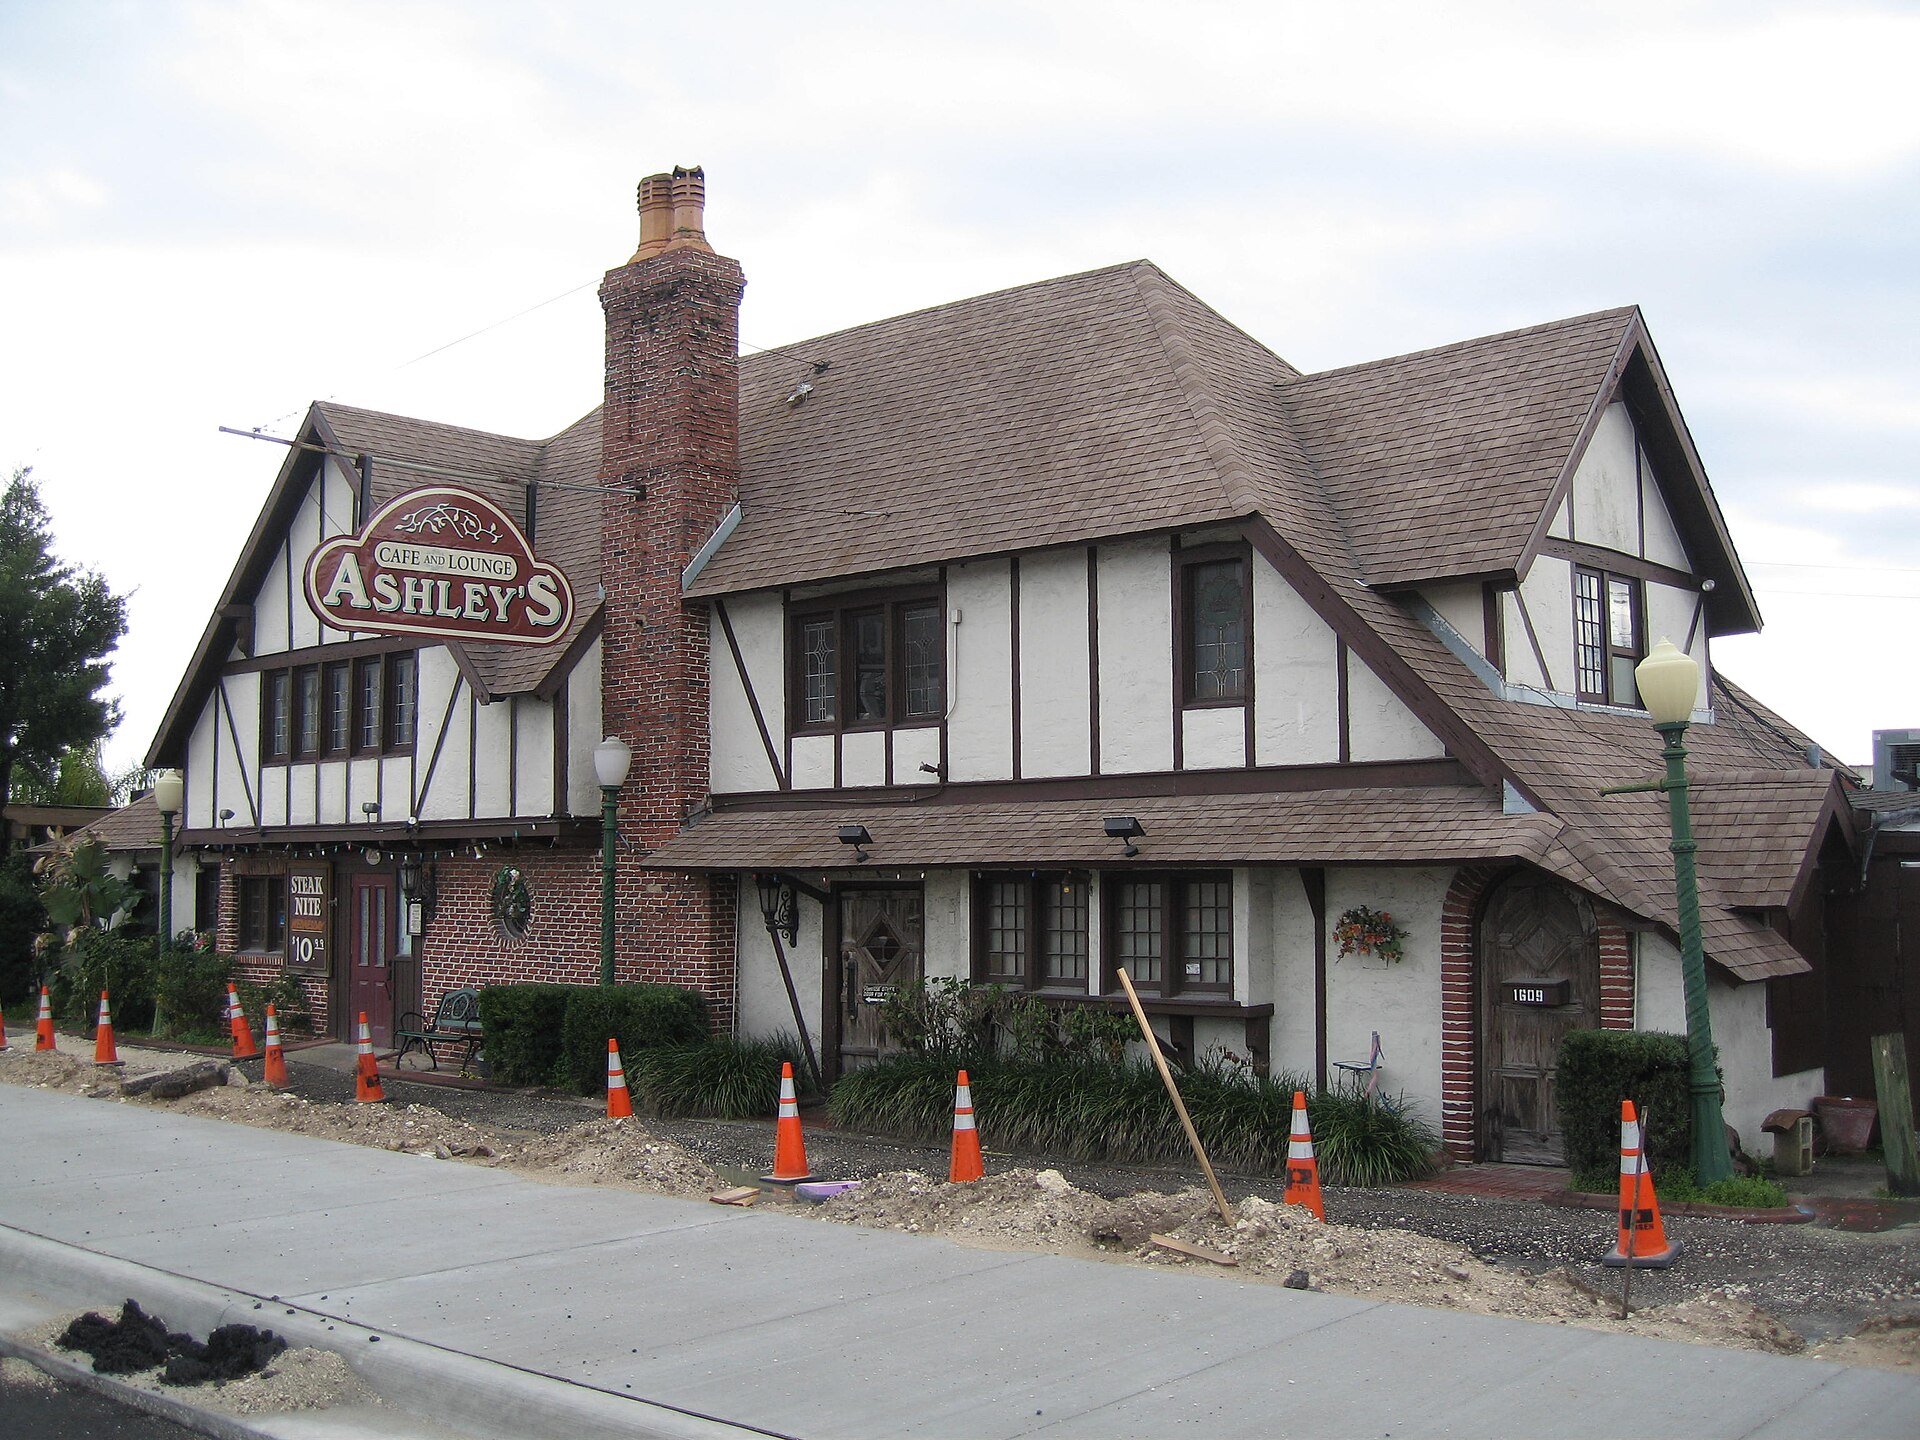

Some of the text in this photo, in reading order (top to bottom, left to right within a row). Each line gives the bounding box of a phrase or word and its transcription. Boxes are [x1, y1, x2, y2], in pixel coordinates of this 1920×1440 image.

[379, 547, 512, 576] CAFE AND LOUNGE
[322, 552, 563, 627] ASHLEY'S
[291, 876, 323, 895] STEAK
[294, 897, 321, 916] NITE
[1513, 988, 1543, 1002] 1609
